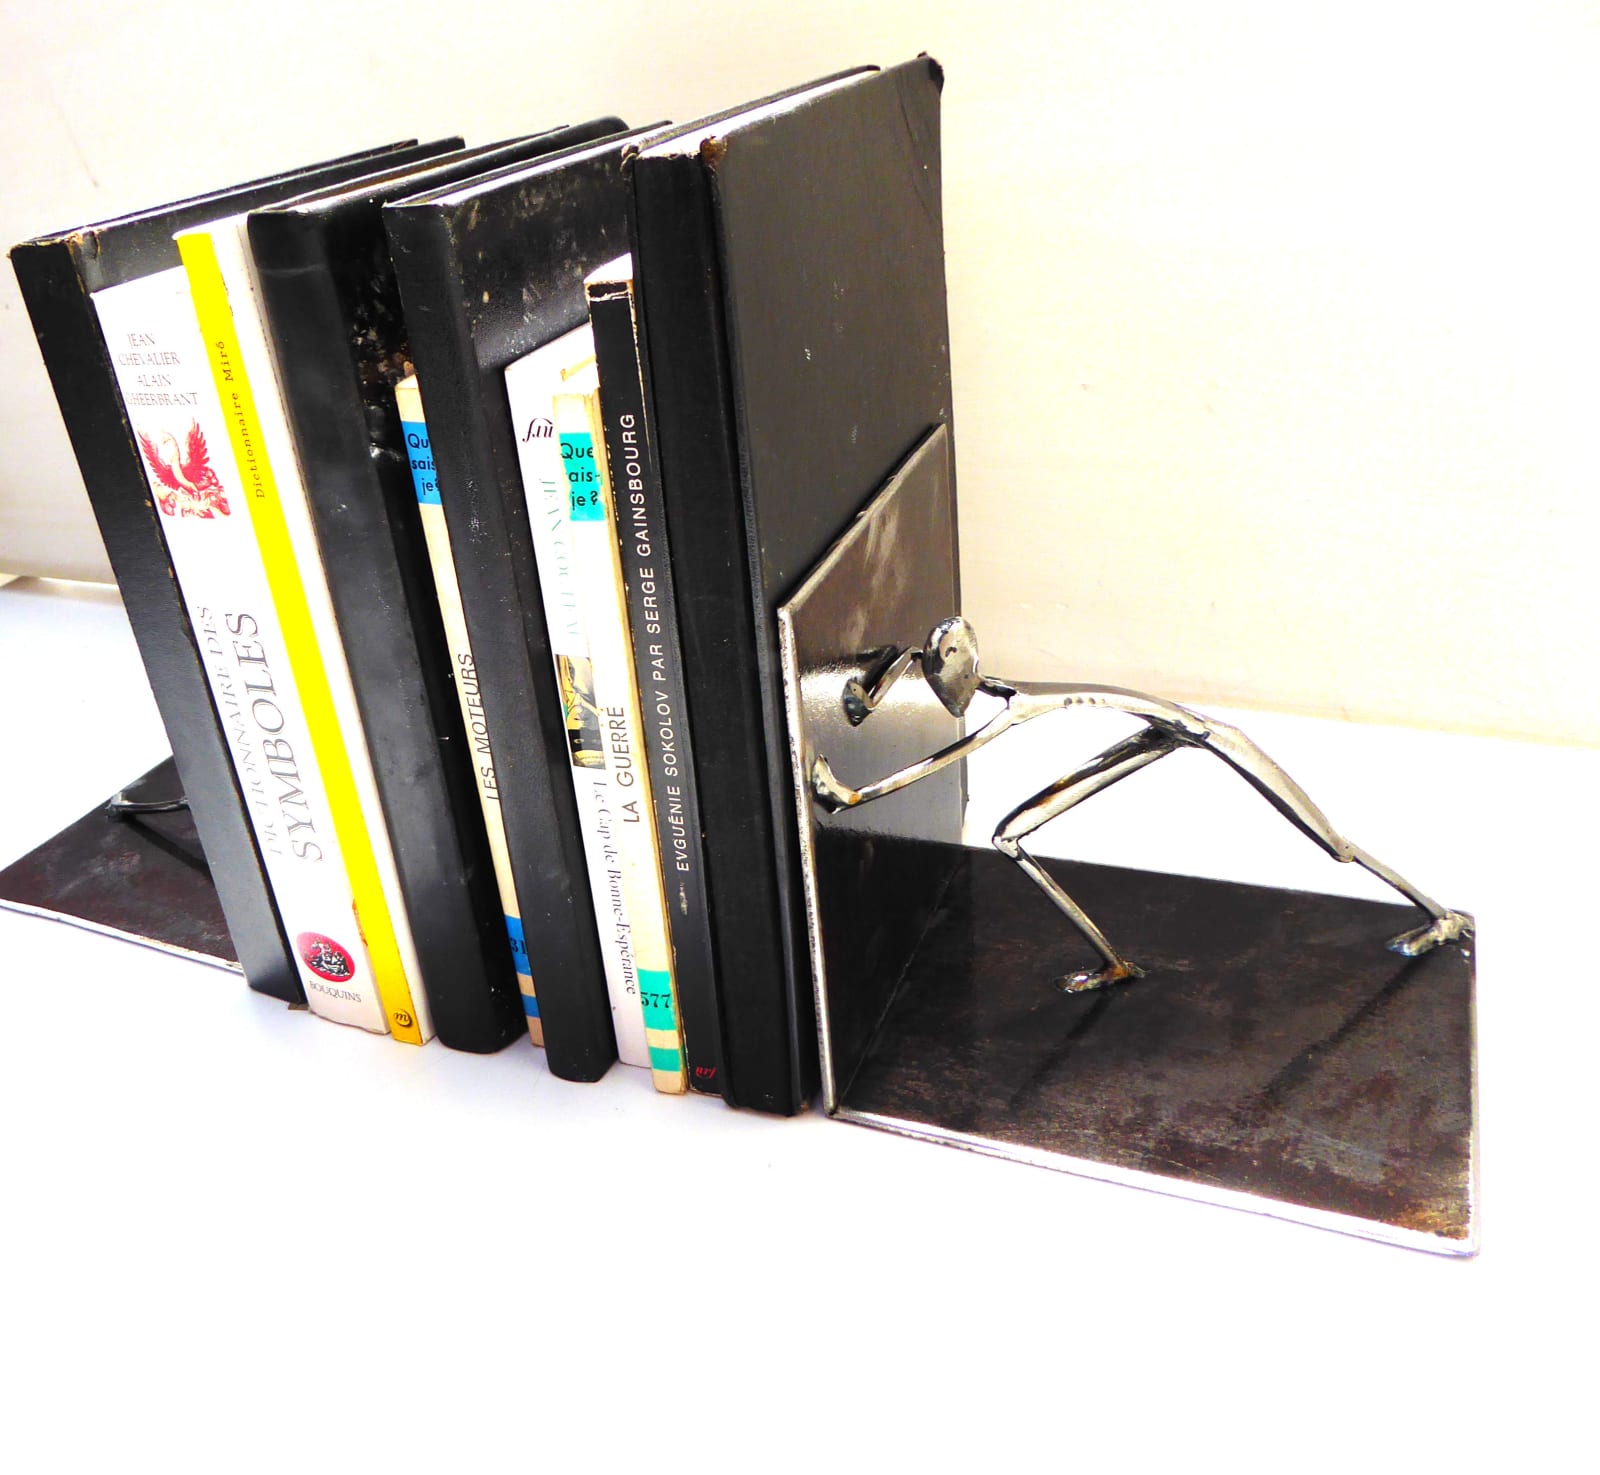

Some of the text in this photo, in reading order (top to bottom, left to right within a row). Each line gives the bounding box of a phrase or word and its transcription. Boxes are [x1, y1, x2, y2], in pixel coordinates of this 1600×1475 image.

[126, 332, 155, 349] JEAN
[118, 351, 180, 366] CHEVALIER
[137, 374, 172, 387] ALAIN
[215, 341, 265, 498] Dictionnaire Miró
[407, 433, 429, 449] Qu
[560, 443, 594, 459] Que
[620, 414, 690, 872] EVGUÉNIE SOKOLOV PAR SERGE GAINSBOURG
[225, 612, 324, 863] SYMBOLES
[457, 652, 500, 801] LES MOTEURS
[607, 706, 640, 823] LA GUERRE
[593, 781, 637, 996] Le Cap de Bonne-Espérance
[309, 980, 362, 1003] BOUQUINS
[640, 992, 671, 1009] 577
